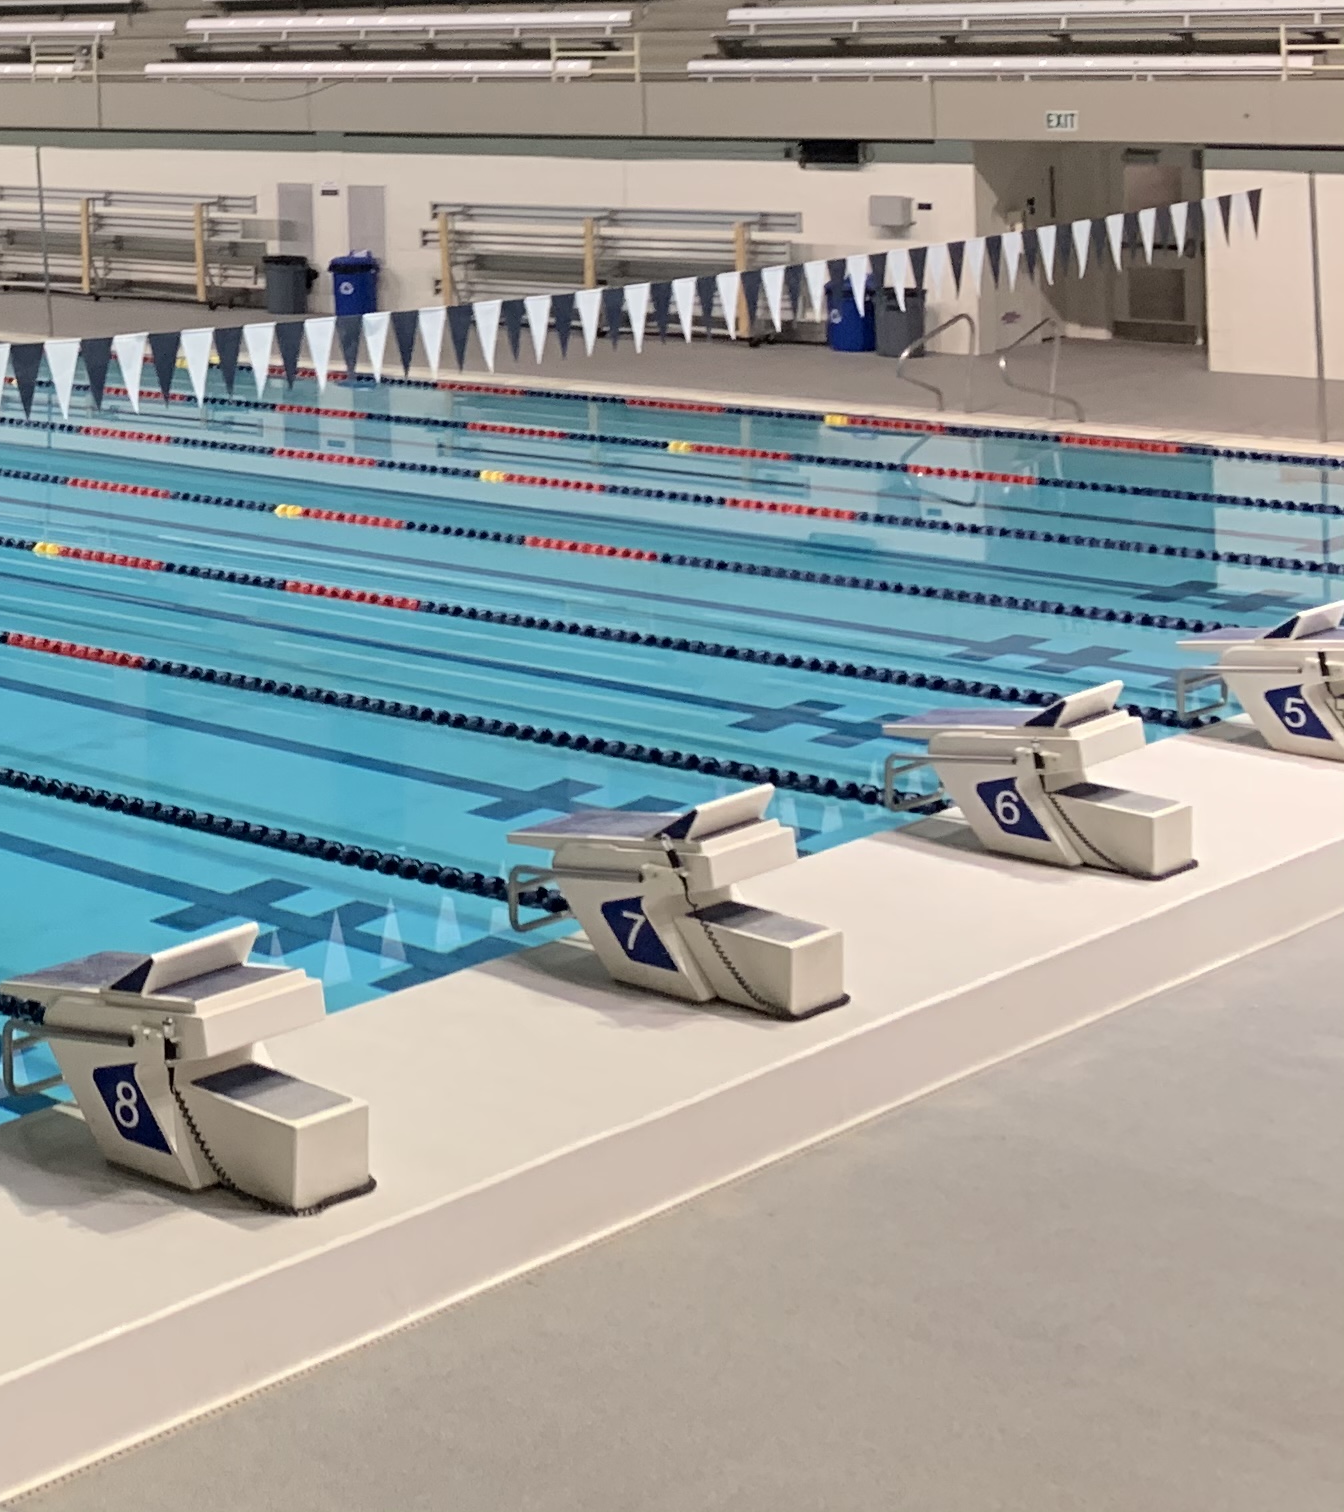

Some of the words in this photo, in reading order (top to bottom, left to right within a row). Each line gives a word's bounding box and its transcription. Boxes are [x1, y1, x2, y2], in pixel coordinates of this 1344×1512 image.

[1047, 113, 1075, 128] EXIT
[1284, 697, 1306, 728] 5
[995, 790, 1020, 825] 6
[622, 910, 646, 951] 7
[115, 1081, 139, 1128] 8
